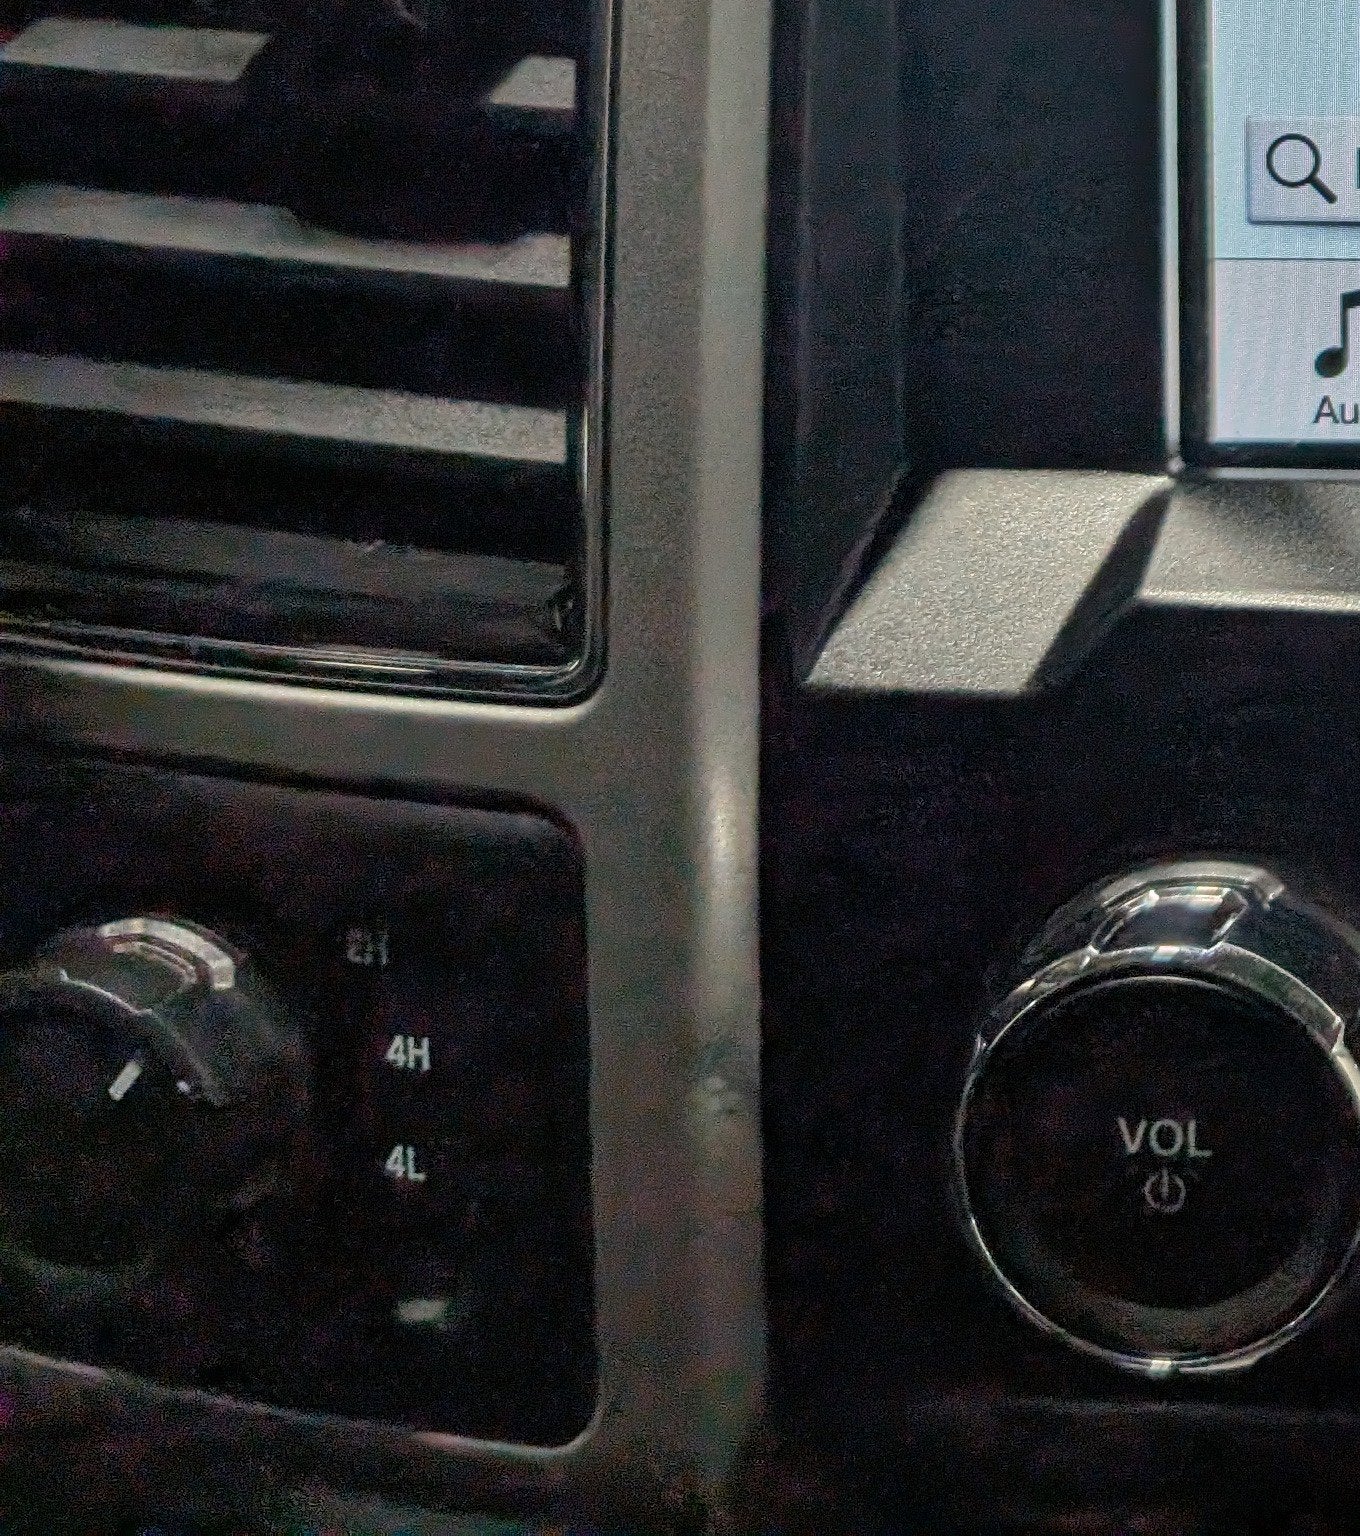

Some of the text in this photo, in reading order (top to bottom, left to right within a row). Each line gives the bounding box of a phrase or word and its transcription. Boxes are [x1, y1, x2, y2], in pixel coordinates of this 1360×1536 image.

[385, 1035, 432, 1071] 4H
[1117, 1116, 1213, 1159] VOL
[384, 1144, 426, 1180] 4L
